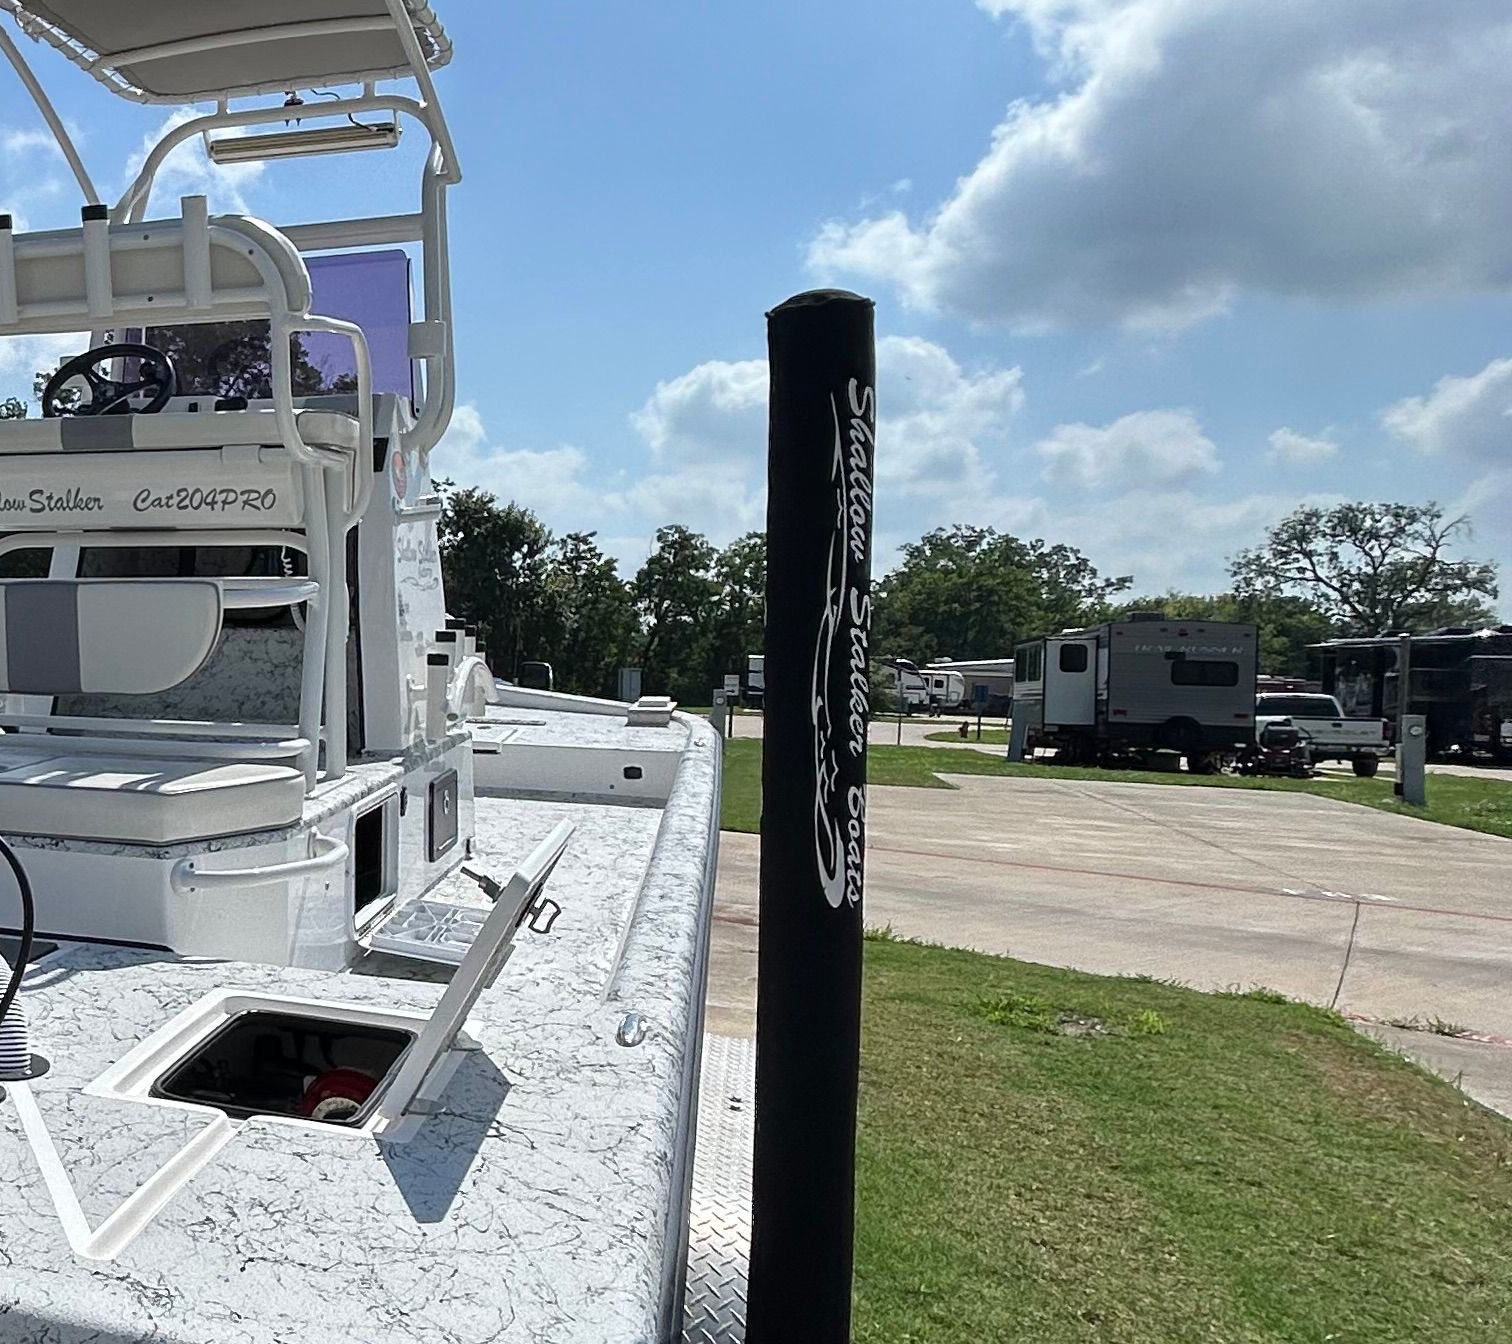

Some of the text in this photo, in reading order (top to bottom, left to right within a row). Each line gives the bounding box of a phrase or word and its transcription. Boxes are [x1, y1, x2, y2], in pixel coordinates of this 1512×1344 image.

[29, 487, 104, 514] Stalker
[847, 377, 875, 908] Shallow Stalker Boats
